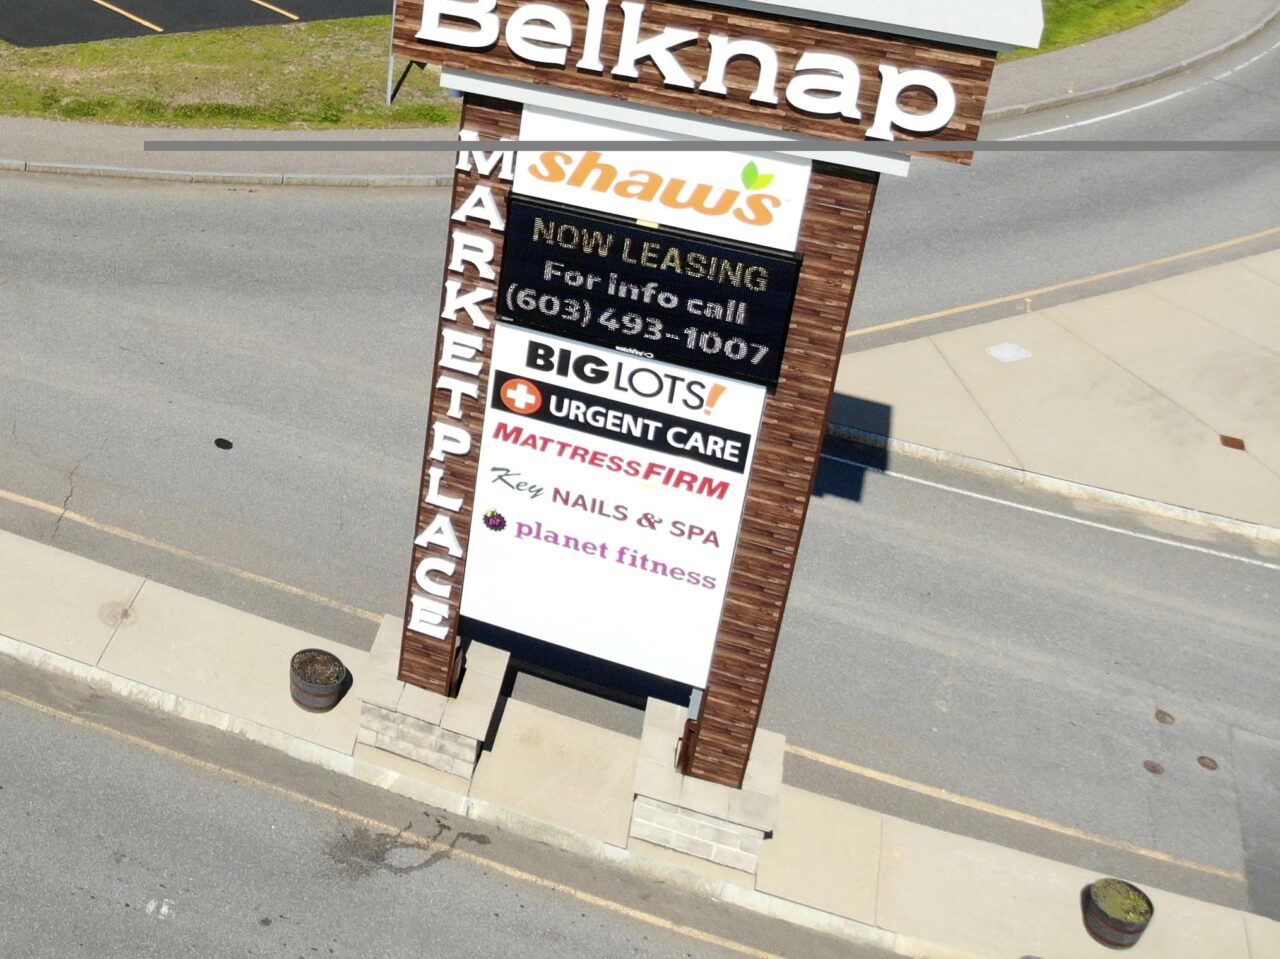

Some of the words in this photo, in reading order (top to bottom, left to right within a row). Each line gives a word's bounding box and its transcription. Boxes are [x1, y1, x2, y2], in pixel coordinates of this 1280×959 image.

[531, 217, 614, 258] NOW
[621, 238, 769, 292] LEASING
[506, 282, 592, 328] (603)
[599, 306, 770, 366] 493-1007
[543, 259, 602, 291] For
[687, 298, 747, 325] call
[407, 129, 519, 640] MARKETPLACE
[525, 340, 609, 384] BIG
[549, 395, 663, 441] URGENT
[666, 427, 742, 463] CARE
[490, 467, 544, 499] Key
[551, 487, 629, 522] NAILS
[636, 512, 663, 531] &
[669, 520, 720, 548] SPA
[514, 520, 609, 560] planet
[616, 545, 717, 590] fitness
